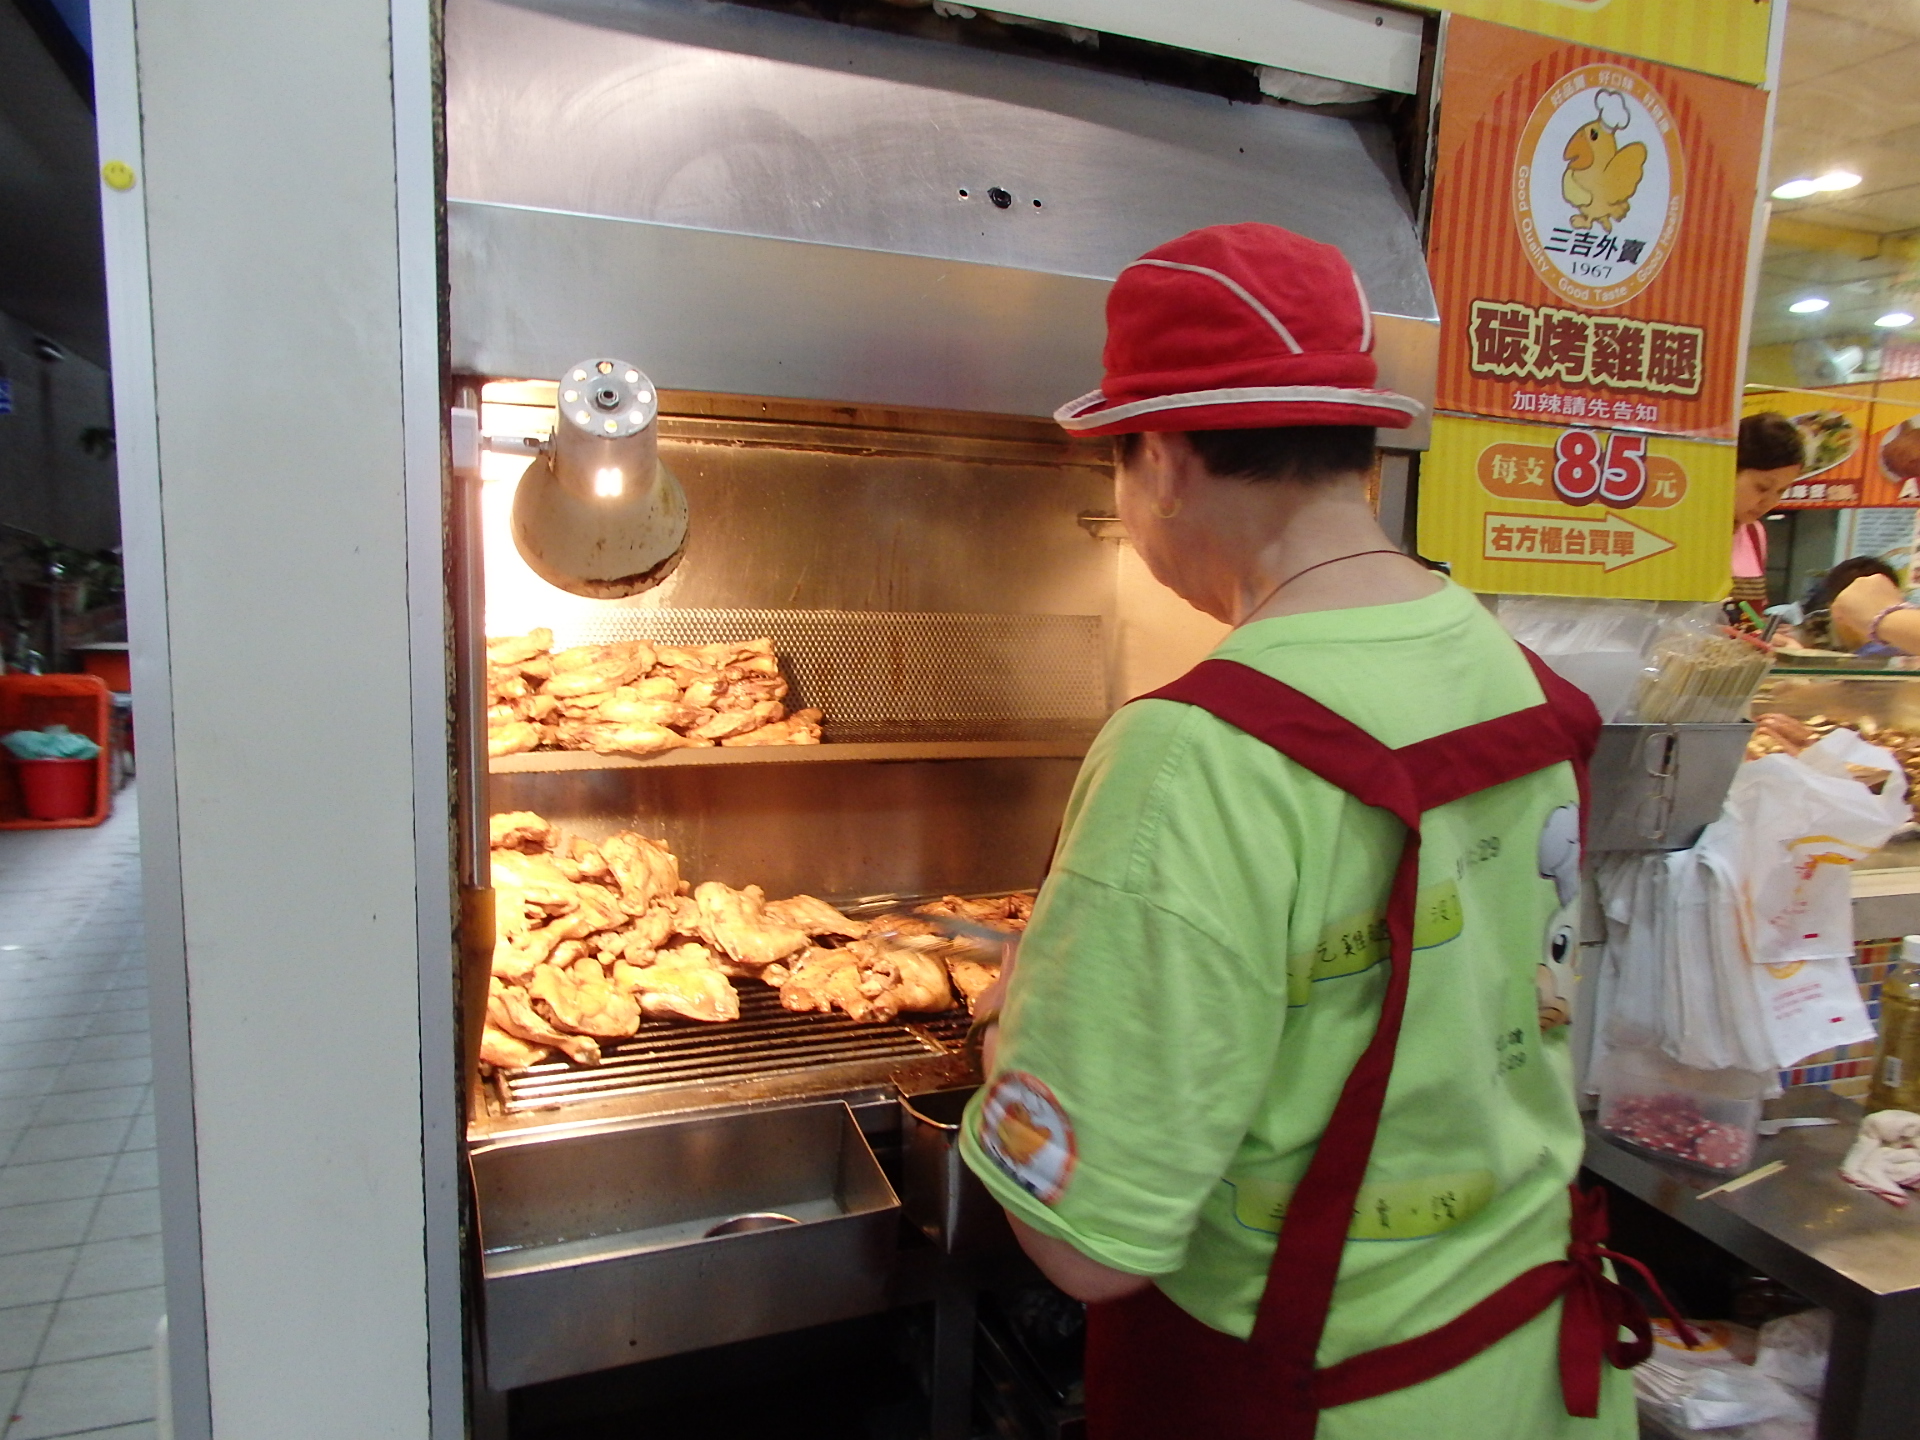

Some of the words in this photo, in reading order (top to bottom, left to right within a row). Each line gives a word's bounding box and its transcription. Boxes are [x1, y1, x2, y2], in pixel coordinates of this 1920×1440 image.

[1598, 71, 1635, 90] 好口味
[1517, 165, 1530, 212] Good
[1659, 195, 1681, 246] Health
[1521, 217, 1550, 272] Quality
[1544, 227, 1648, 265] 三吉外賣
[1570, 261, 1613, 280] 1967
[1636, 253, 1663, 283] Good
[1557, 277, 1590, 300] Good
[1593, 284, 1628, 302] Taste
[1472, 302, 1704, 394] 碳烤雞腿
[1511, 391, 1659, 422] 加辣請先告知
[1491, 454, 1545, 486] 每支
[1553, 428, 1648, 504] 85
[1651, 471, 1677, 499] 元
[1490, 523, 1635, 558] 右方櫃台買單
